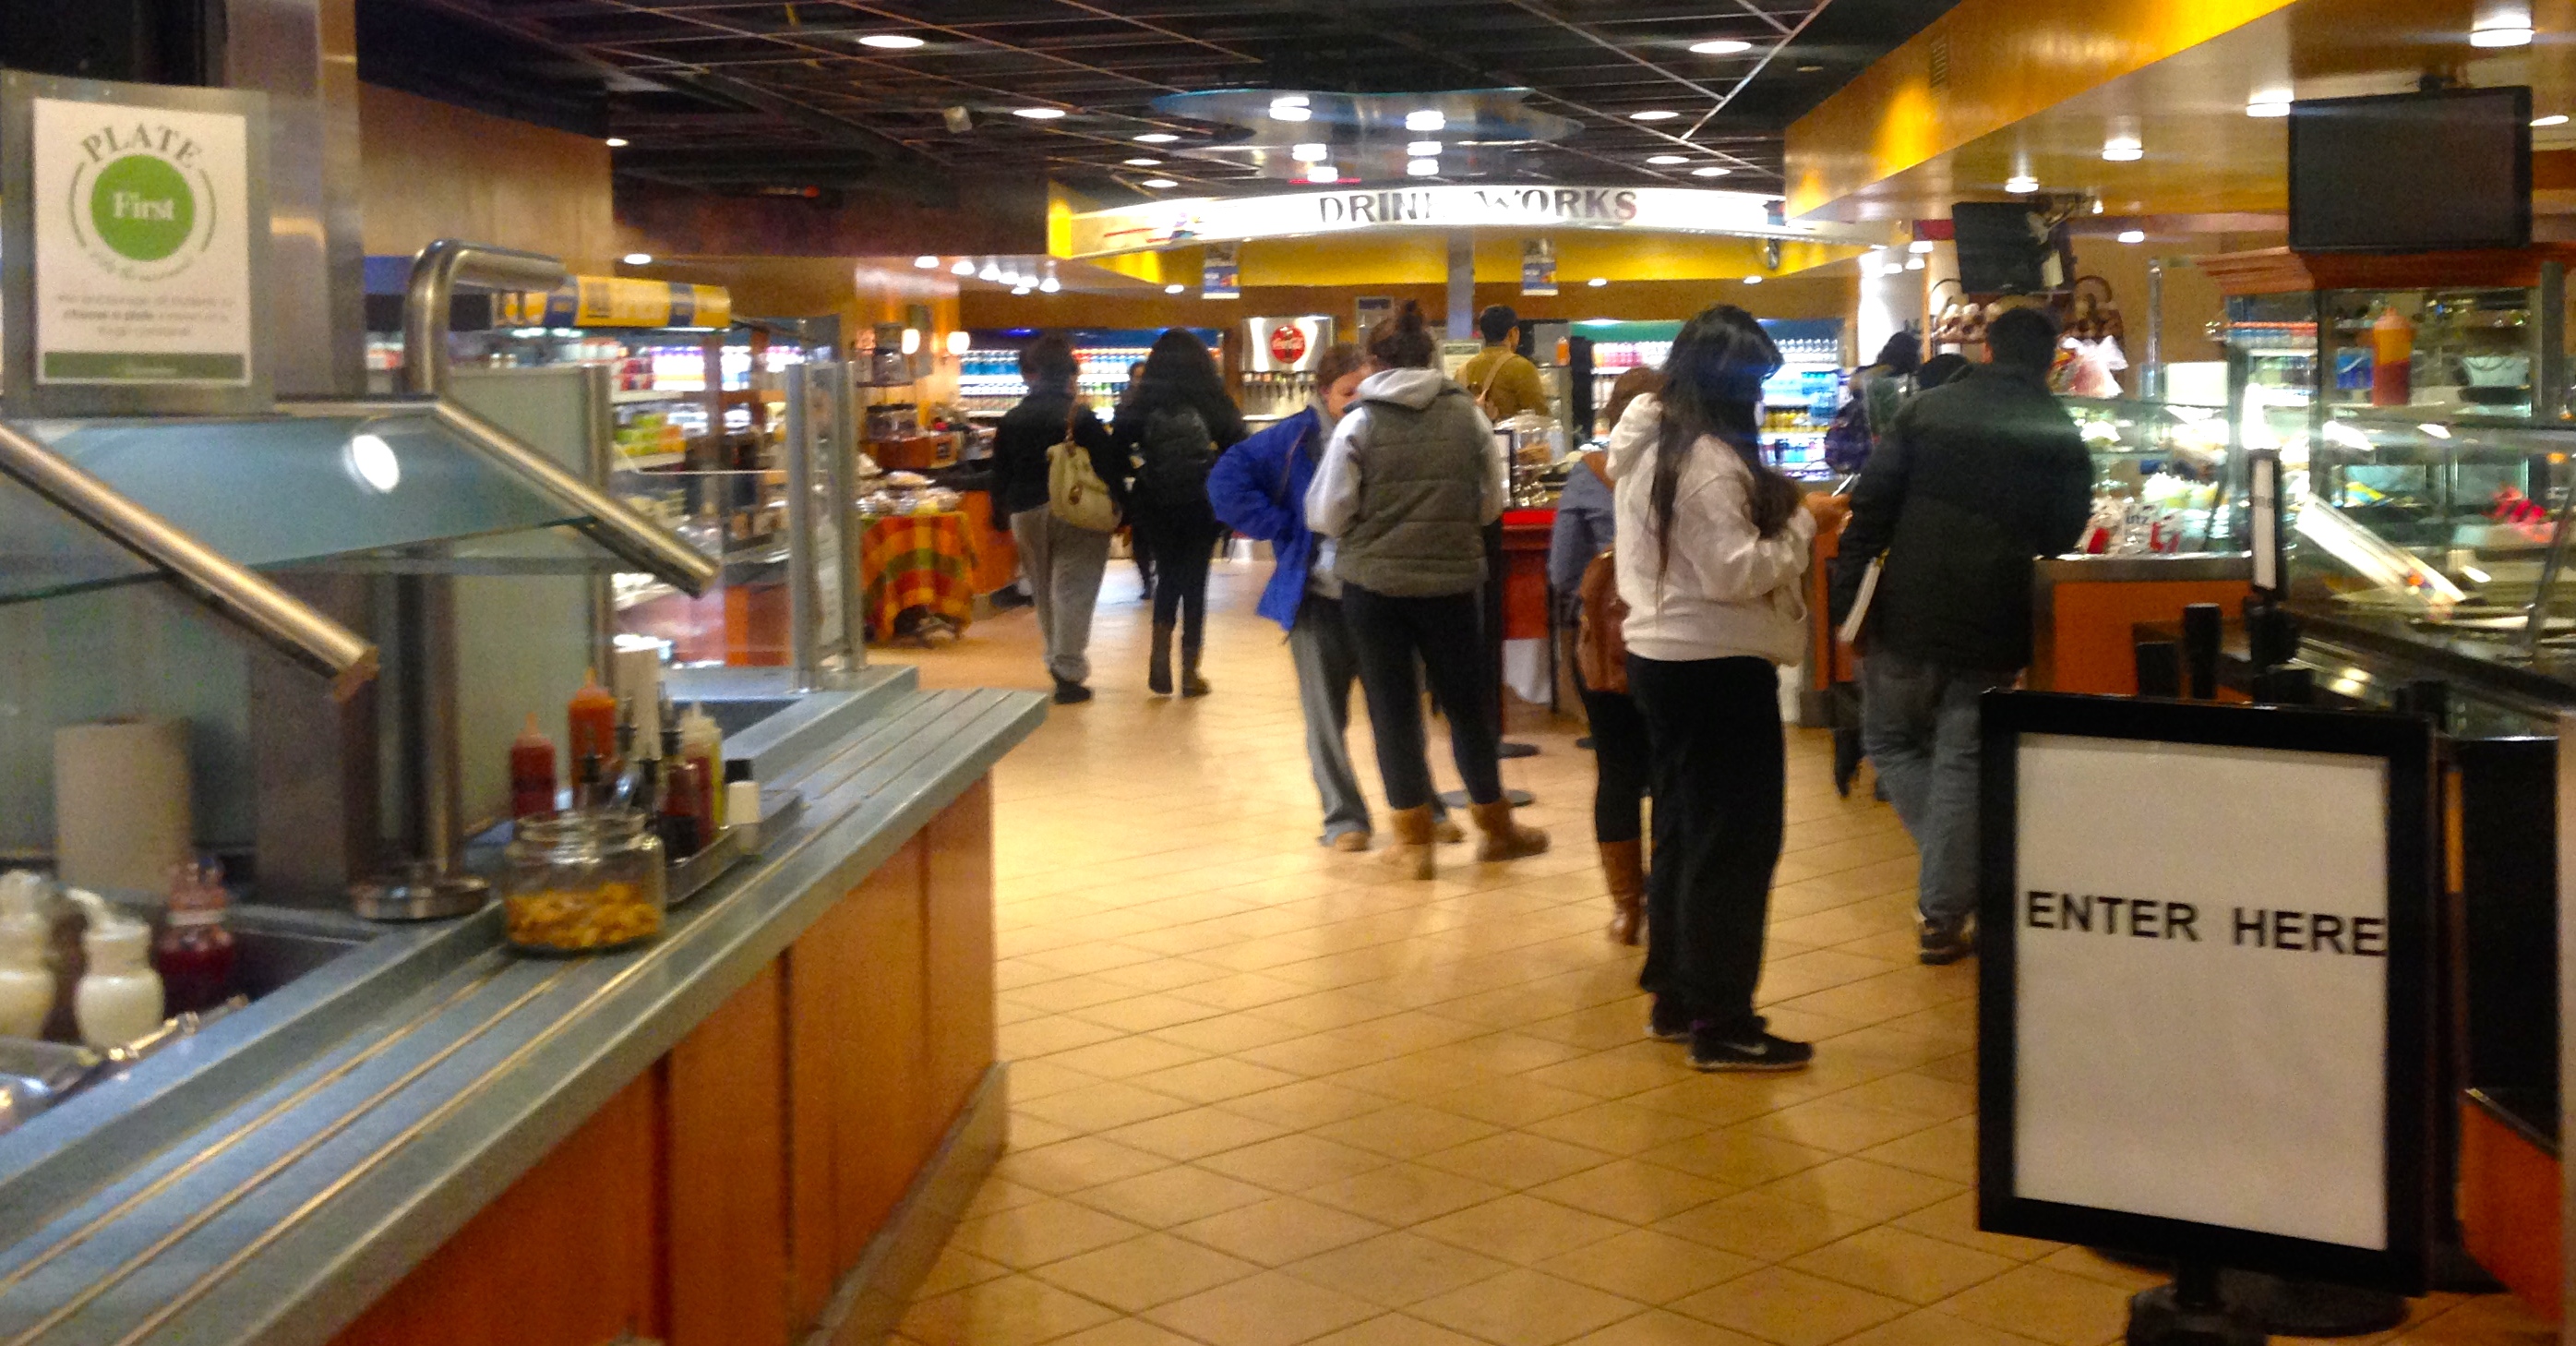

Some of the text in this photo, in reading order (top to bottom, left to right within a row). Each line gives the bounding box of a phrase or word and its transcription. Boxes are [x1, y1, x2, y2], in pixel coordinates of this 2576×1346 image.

[81, 122, 203, 169] PLATE
[112, 189, 175, 222] First
[1319, 190, 1436, 222] DRIN
[2027, 890, 2389, 958] ENTER HERE
